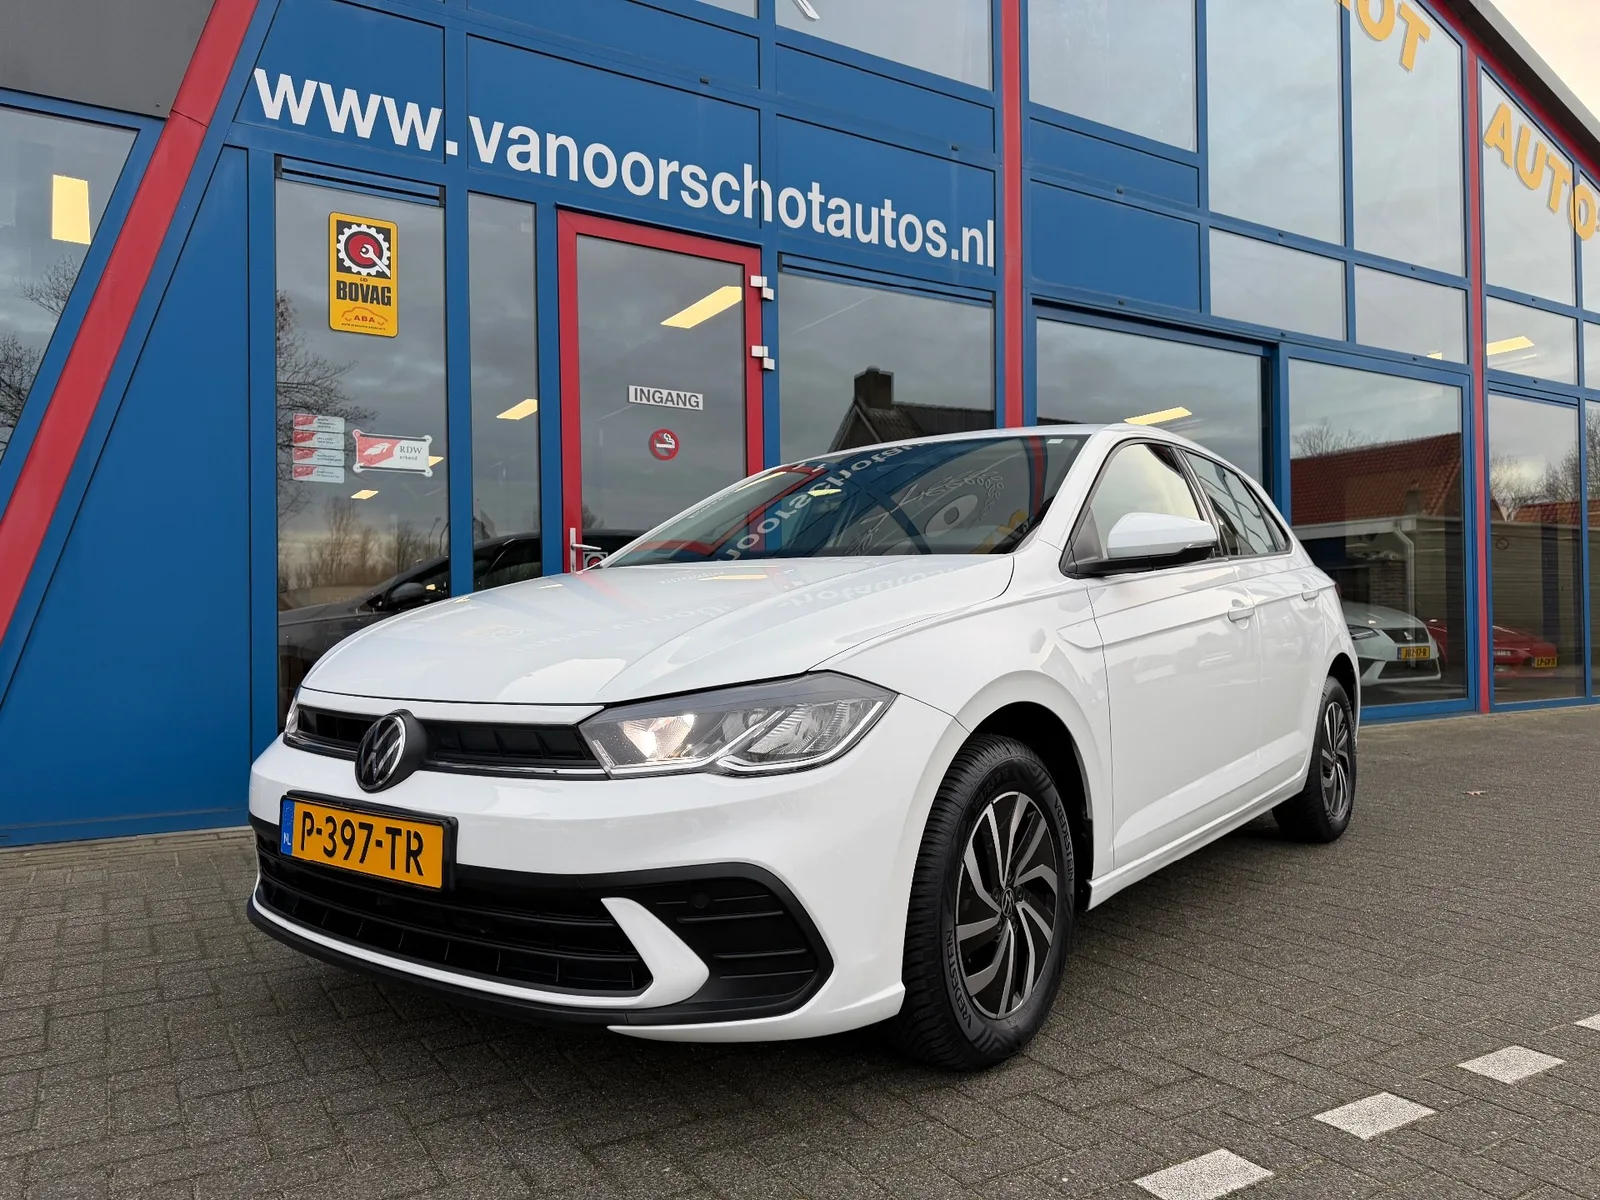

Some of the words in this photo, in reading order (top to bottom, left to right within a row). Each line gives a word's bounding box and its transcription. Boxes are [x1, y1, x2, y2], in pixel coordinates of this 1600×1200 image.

[1336, 0, 1431, 73] OT
[254, 67, 995, 268] www.vanoorschotautos.nl
[1483, 101, 1600, 242] AUTO
[336, 279, 392, 307] BOVAG
[353, 314, 376, 324] ABA
[634, 387, 700, 409] INGANG
[399, 445, 423, 454] RDW
[283, 832, 291, 846] NL
[300, 810, 424, 876] P-397-TR
